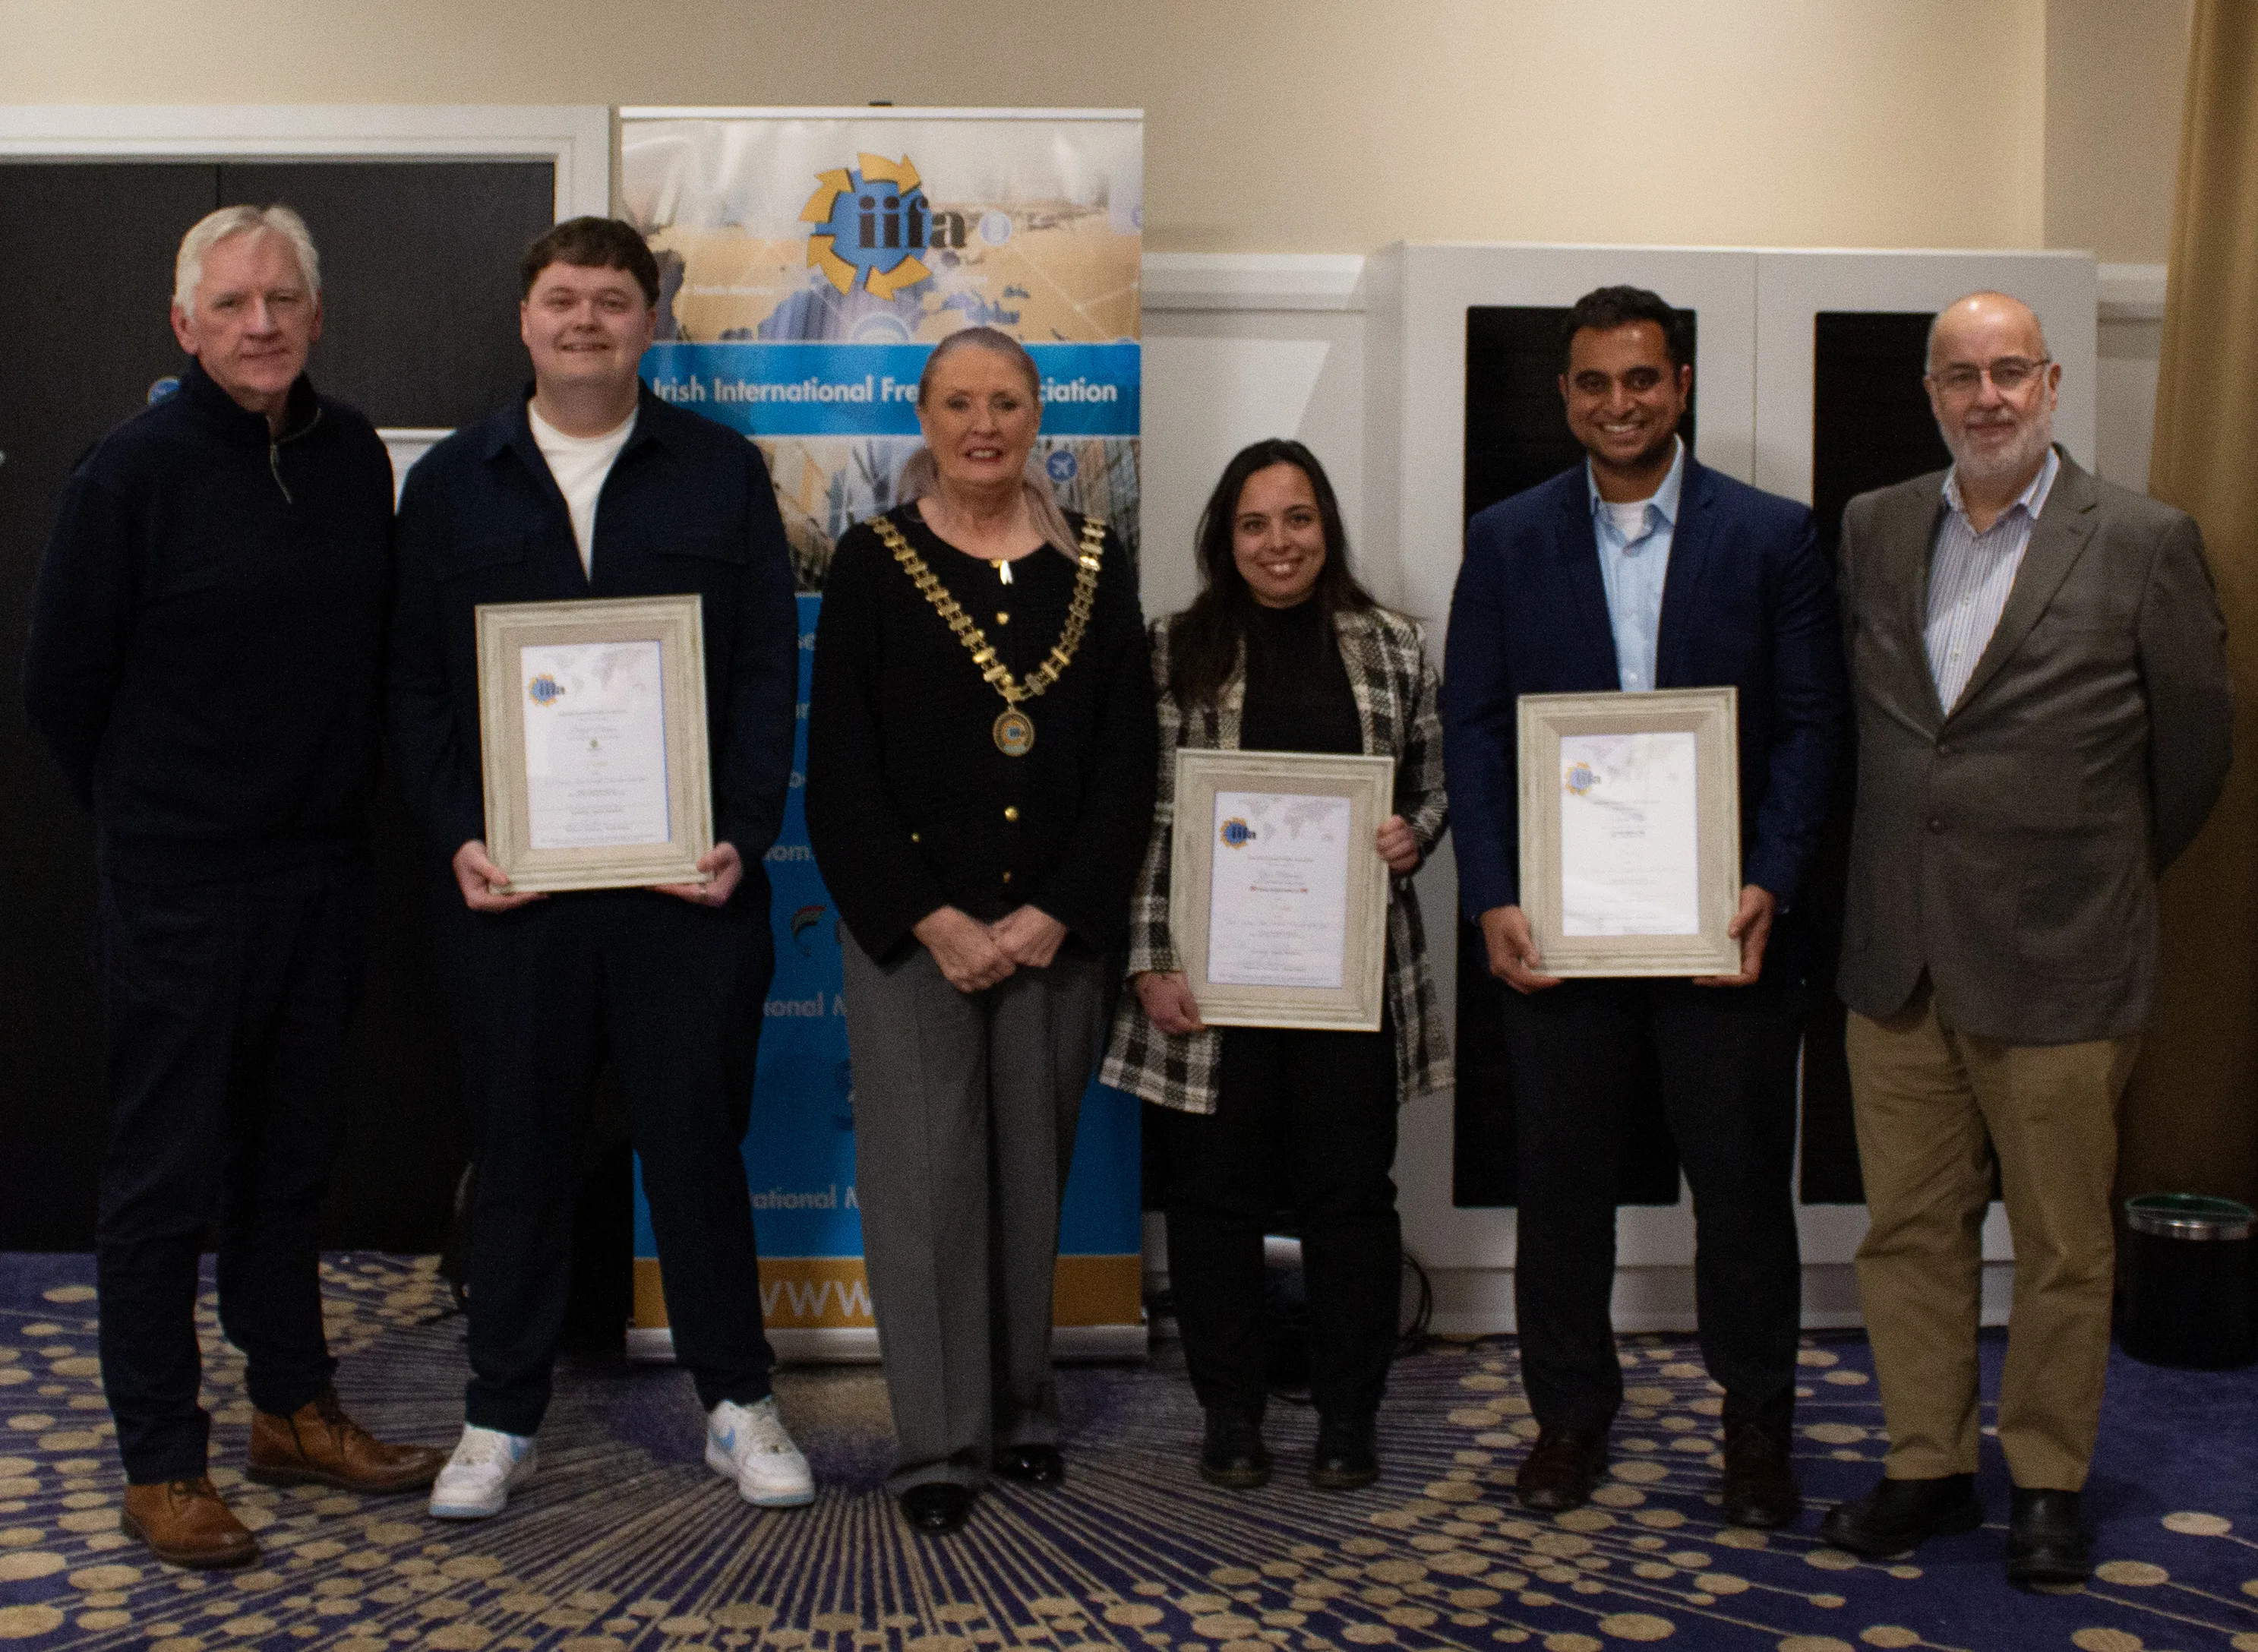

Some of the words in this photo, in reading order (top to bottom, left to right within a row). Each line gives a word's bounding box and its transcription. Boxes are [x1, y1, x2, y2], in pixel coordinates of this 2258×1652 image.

[859, 195, 967, 249] iifa
[653, 375, 706, 403] Irish
[713, 374, 873, 403] International
[880, 377, 920, 403] Fre
[1040, 377, 1118, 403] ciation
[763, 991, 824, 1016] ional
[750, 1184, 837, 1209] ational
